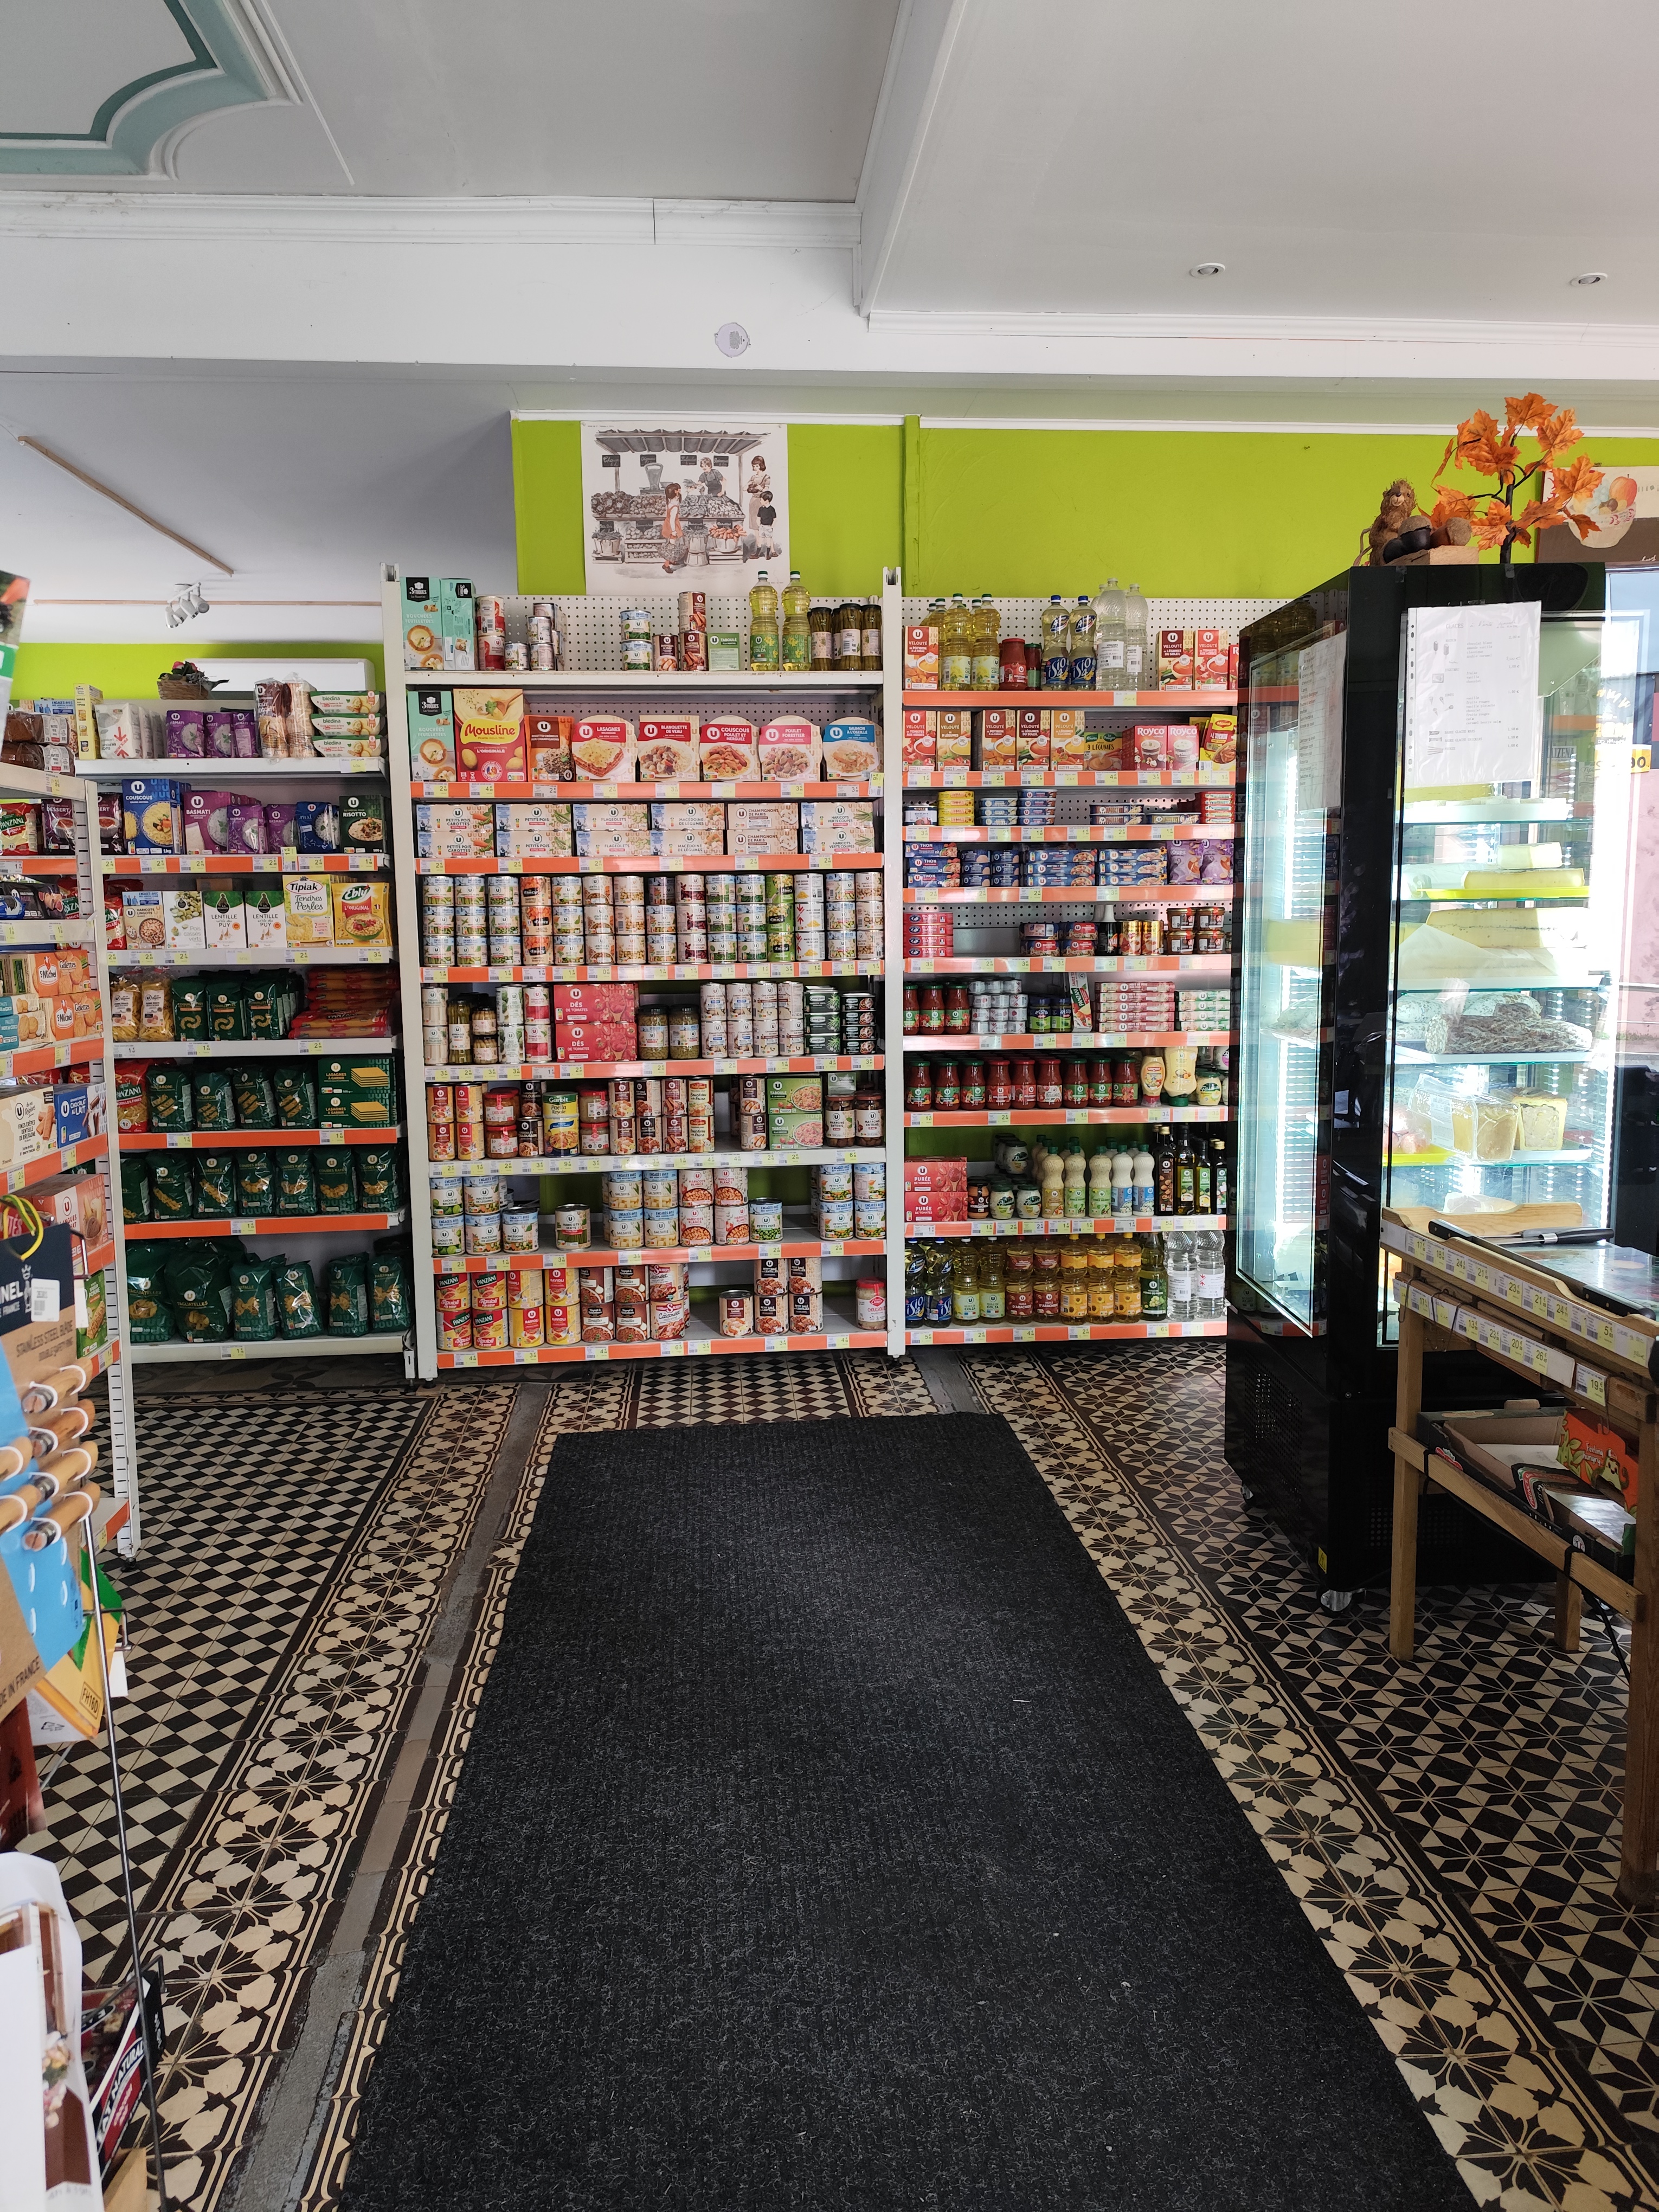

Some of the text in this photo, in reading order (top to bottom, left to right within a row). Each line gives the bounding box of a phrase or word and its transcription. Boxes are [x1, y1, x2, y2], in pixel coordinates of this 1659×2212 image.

[465, 724, 516, 736] Mousline
[290, 883, 318, 892] Tipiak
[344, 885, 370, 899] Ebly
[295, 902, 324, 911] Perles
